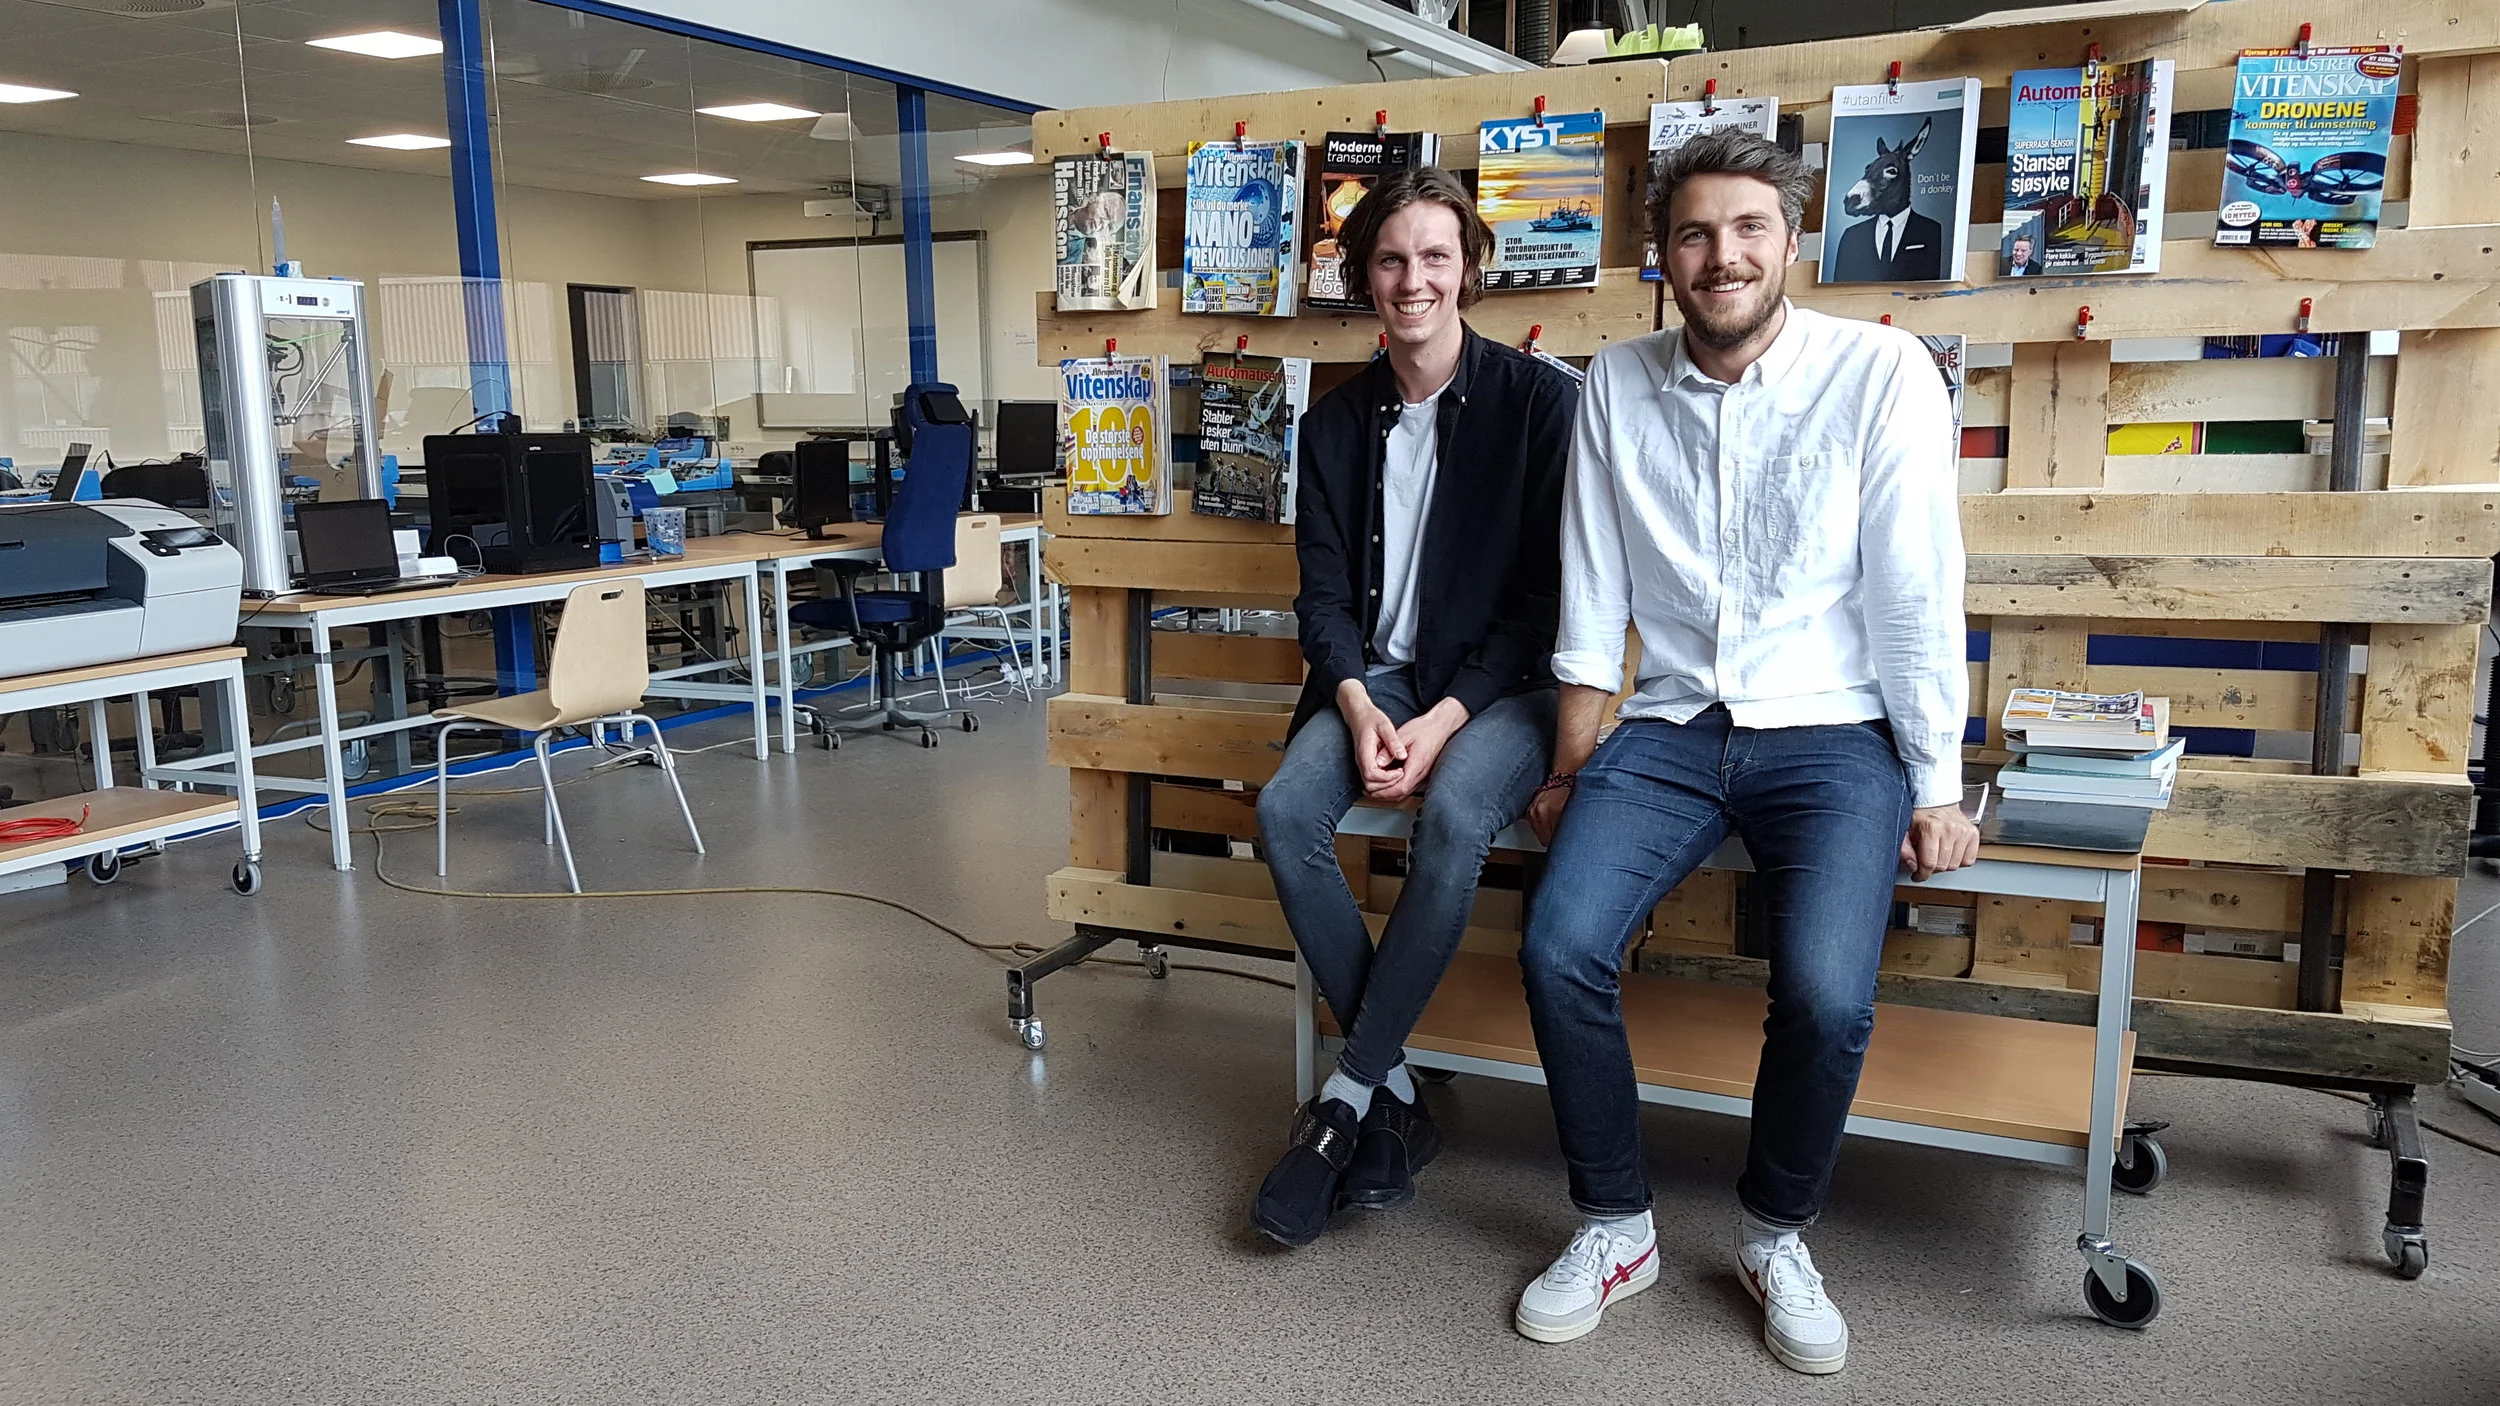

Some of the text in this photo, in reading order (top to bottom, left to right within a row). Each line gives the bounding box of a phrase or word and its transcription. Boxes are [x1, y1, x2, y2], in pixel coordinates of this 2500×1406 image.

[2241, 73, 2396, 98] VITENSKAP
[1842, 92, 1905, 106] #utanfilter
[2260, 101, 2368, 119] DRONENE
[1658, 123, 1711, 139] EXEL-
[2245, 119, 2377, 130] kommer til unnsetning
[1479, 122, 1564, 151] KYST
[2014, 139, 2075, 149] SUPERRASK SENSOR
[1328, 140, 1383, 153] Moderne
[1327, 152, 1382, 165] transport
[2012, 153, 2072, 173] Stanser
[1192, 155, 1283, 190] Vitenskap
[1917, 172, 1950, 183] Don't be
[1927, 184, 1954, 194] donkey
[2011, 173, 2070, 197] sjøsyke
[1055, 160, 1075, 260] Hansson
[1192, 199, 1248, 211] Slik vil du merke
[1190, 211, 1260, 247] NANO-
[1504, 243, 1573, 253] MOTOROVERSIKT FOR
[1505, 237, 1522, 245] STOR
[1191, 247, 1275, 268] REVOLUSJONEN
[1504, 250, 1580, 261] NORDISKE FISKEFARTØY
[1065, 371, 1152, 402] Vitenskap
[1202, 409, 1235, 425] Stabler
[1085, 429, 1099, 444] De
[1100, 429, 1131, 444] største
[1206, 424, 1232, 438] esker
[1068, 405, 1153, 483] 100
[1200, 438, 1244, 454] uten bunn
[1081, 445, 1145, 461] oppfinnelsene
